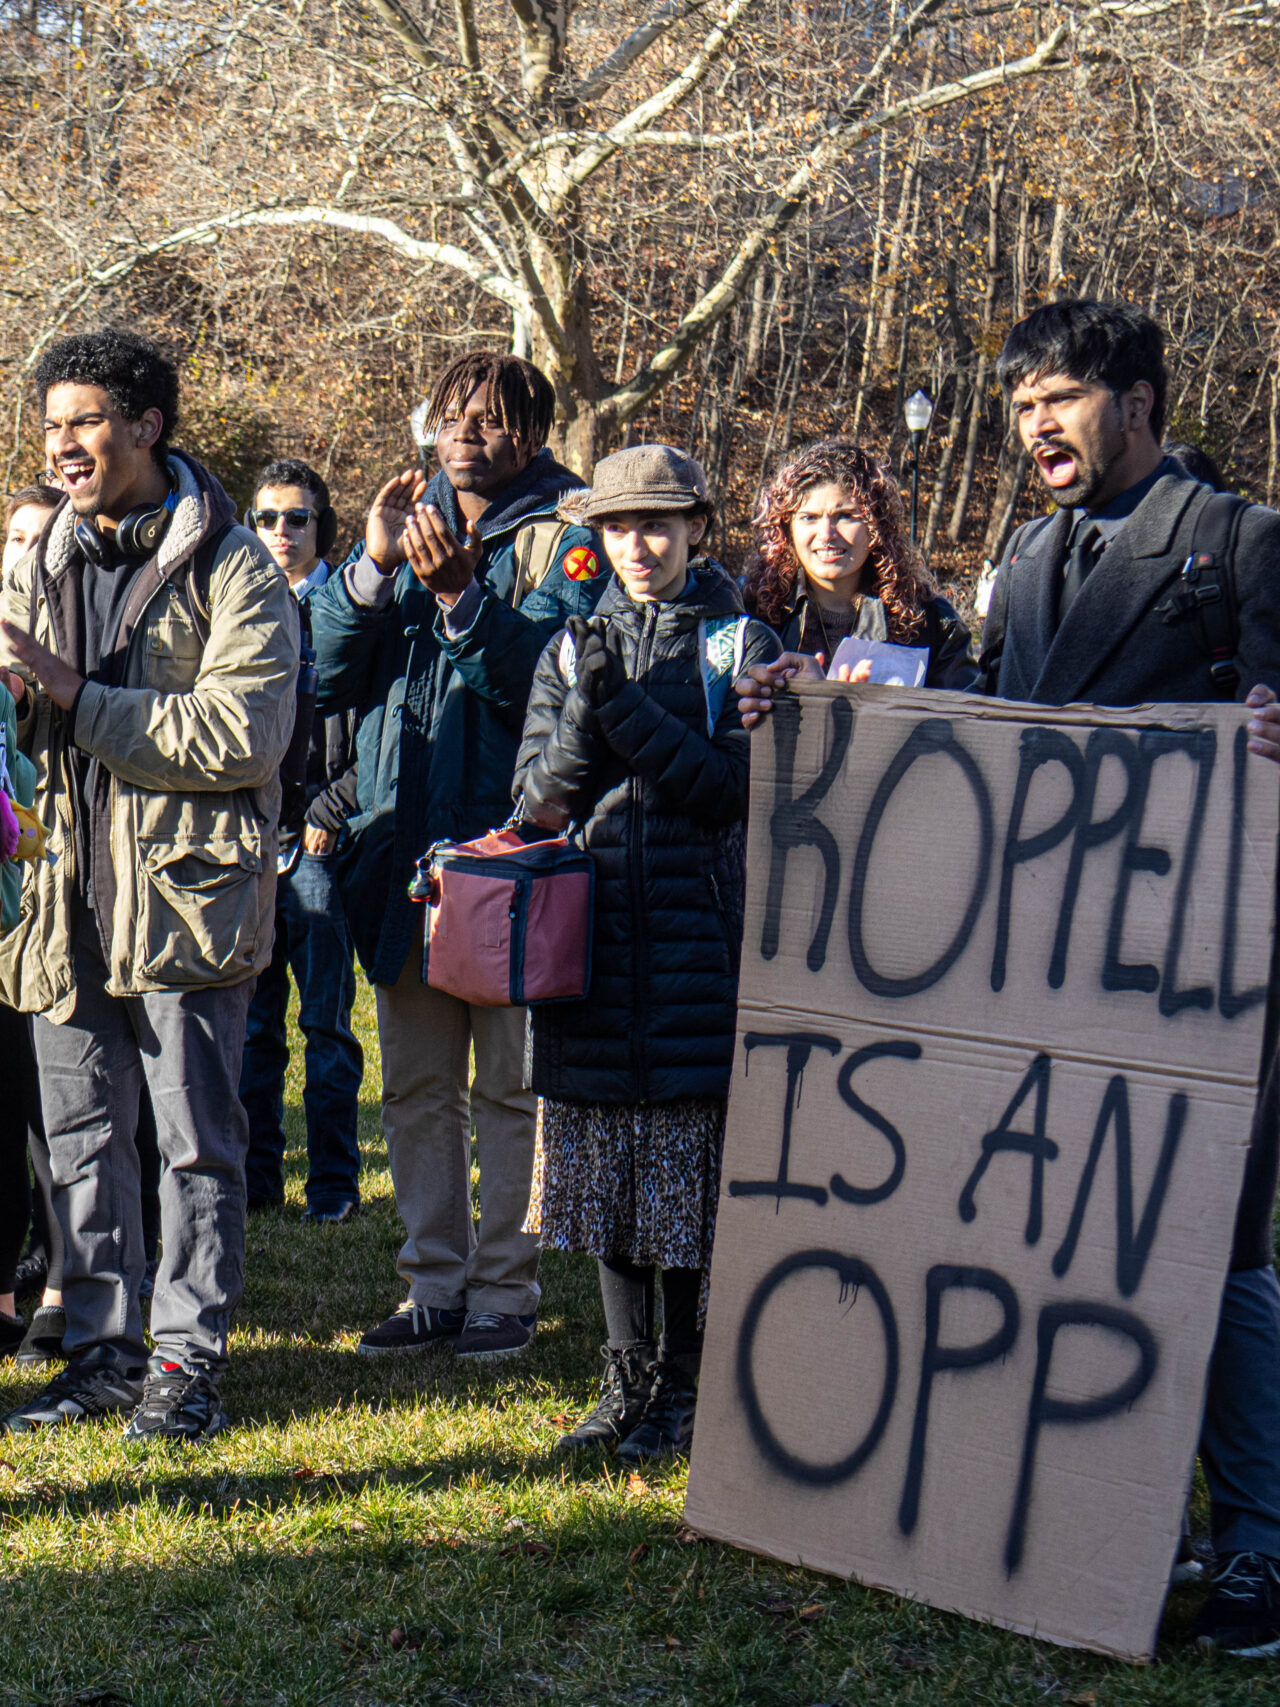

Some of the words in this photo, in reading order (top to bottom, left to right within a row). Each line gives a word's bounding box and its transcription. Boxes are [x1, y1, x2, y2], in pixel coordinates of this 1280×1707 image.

[760, 690, 1269, 1020] KOPPELL
[729, 1031, 922, 1216] IS
[957, 1049, 1190, 1299] AN
[735, 1247, 1161, 1583] OPP
